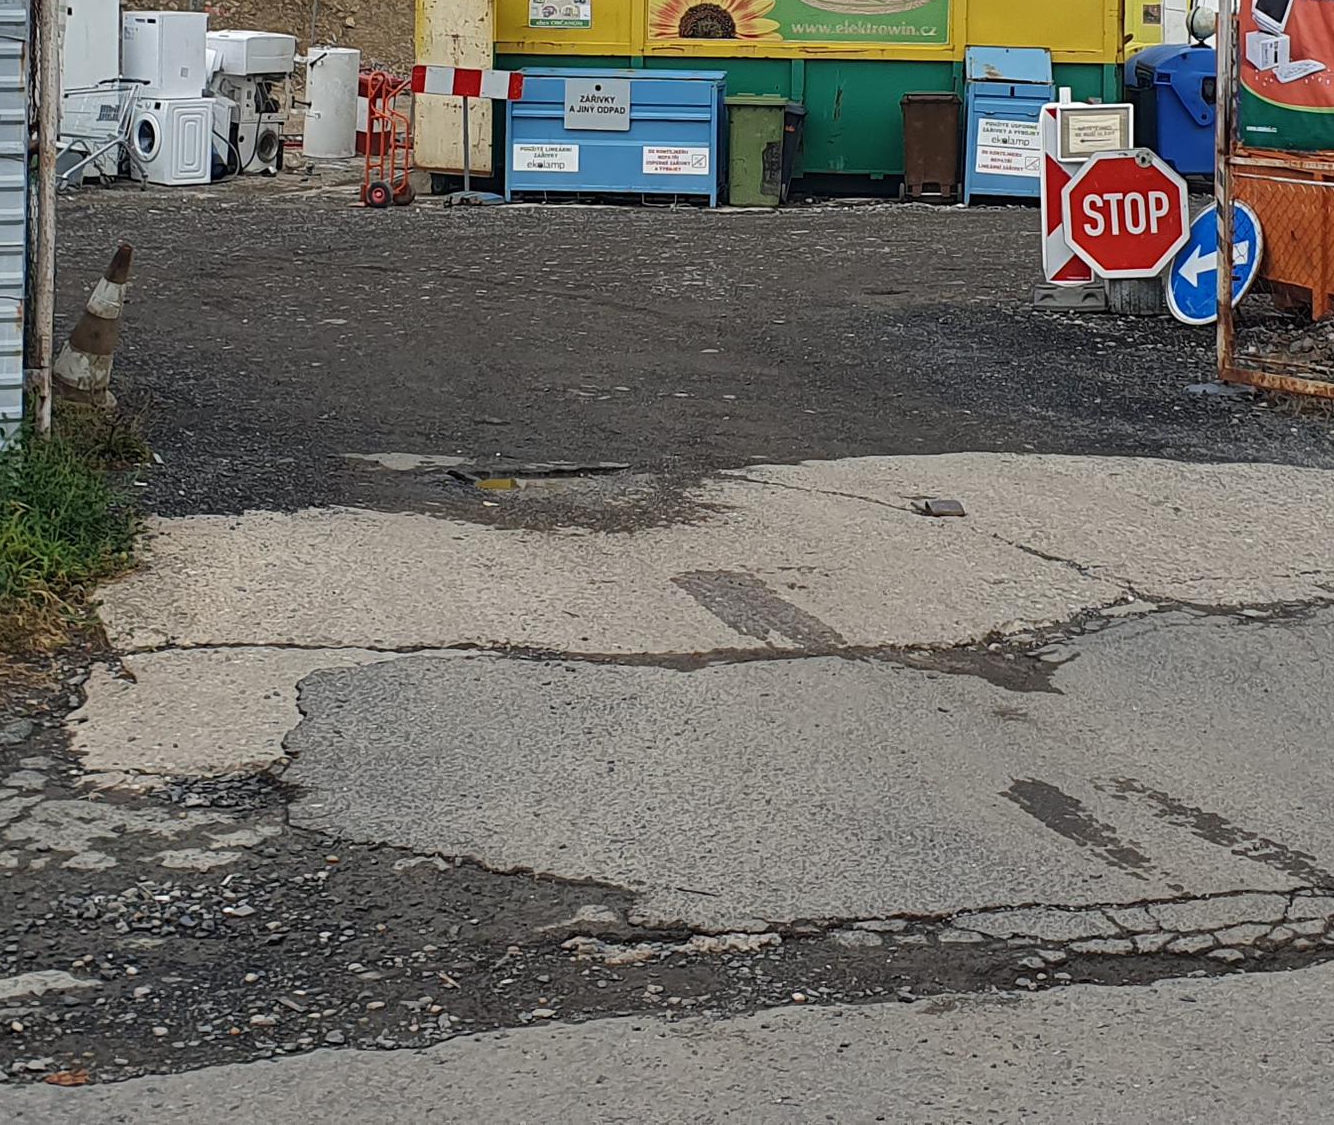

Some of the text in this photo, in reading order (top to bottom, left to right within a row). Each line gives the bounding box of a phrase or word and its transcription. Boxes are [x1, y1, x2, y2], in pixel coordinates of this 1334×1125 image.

[790, 22, 937, 36] www.elektrowin.cz
[579, 94, 616, 104] ZÁŘIVKY
[576, 104, 595, 114] JINÝ
[597, 106, 626, 115] ODPAD
[1082, 190, 1170, 237] STOP
